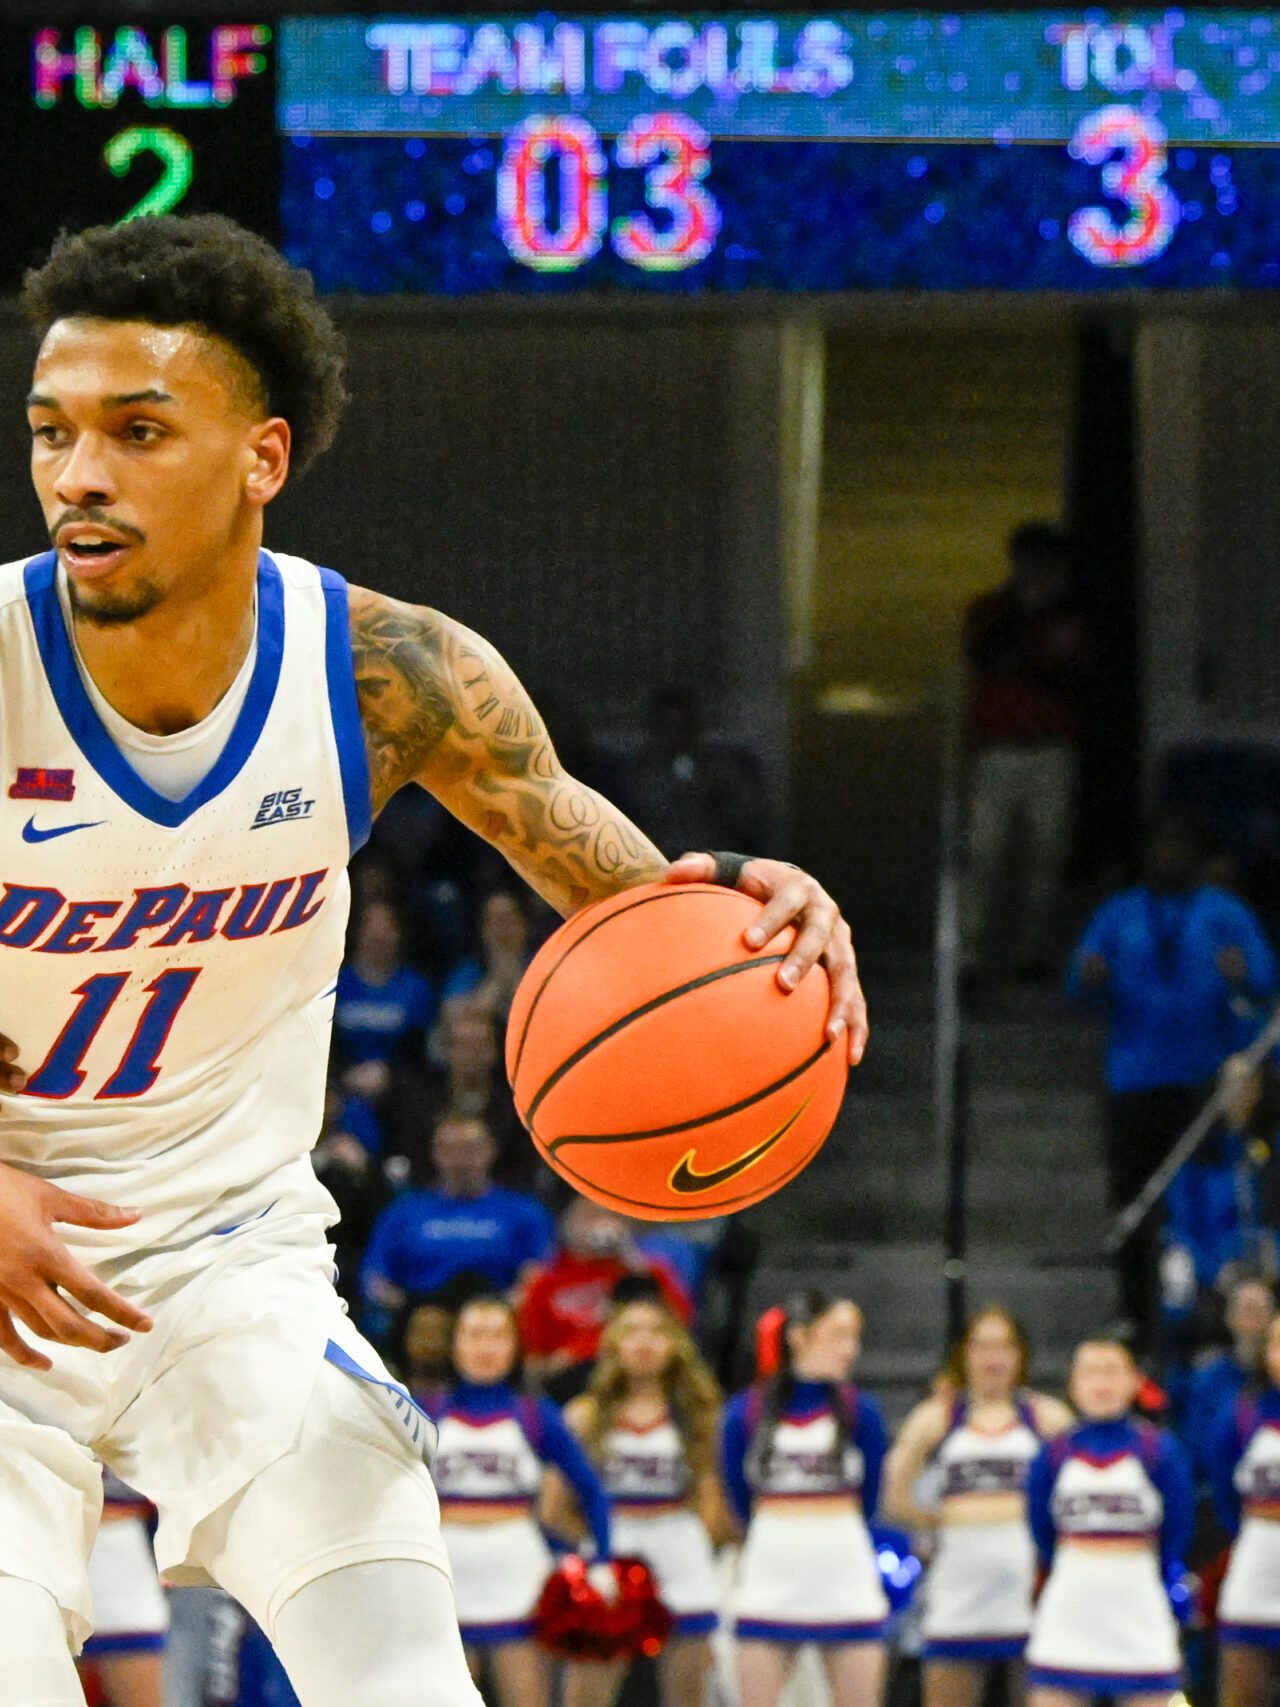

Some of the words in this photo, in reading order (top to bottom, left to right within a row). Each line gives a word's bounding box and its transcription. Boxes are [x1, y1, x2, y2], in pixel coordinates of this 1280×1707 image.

[32, 25, 272, 109] HALF
[365, 22, 586, 96] TEAM
[593, 20, 854, 98] FOULS
[104, 124, 194, 230] 2
[495, 113, 722, 272] 03
[1067, 104, 1181, 268] 3
[254, 799, 316, 823] EAST
[260, 787, 302, 809] BIG
[19, 965, 204, 1101] 11
